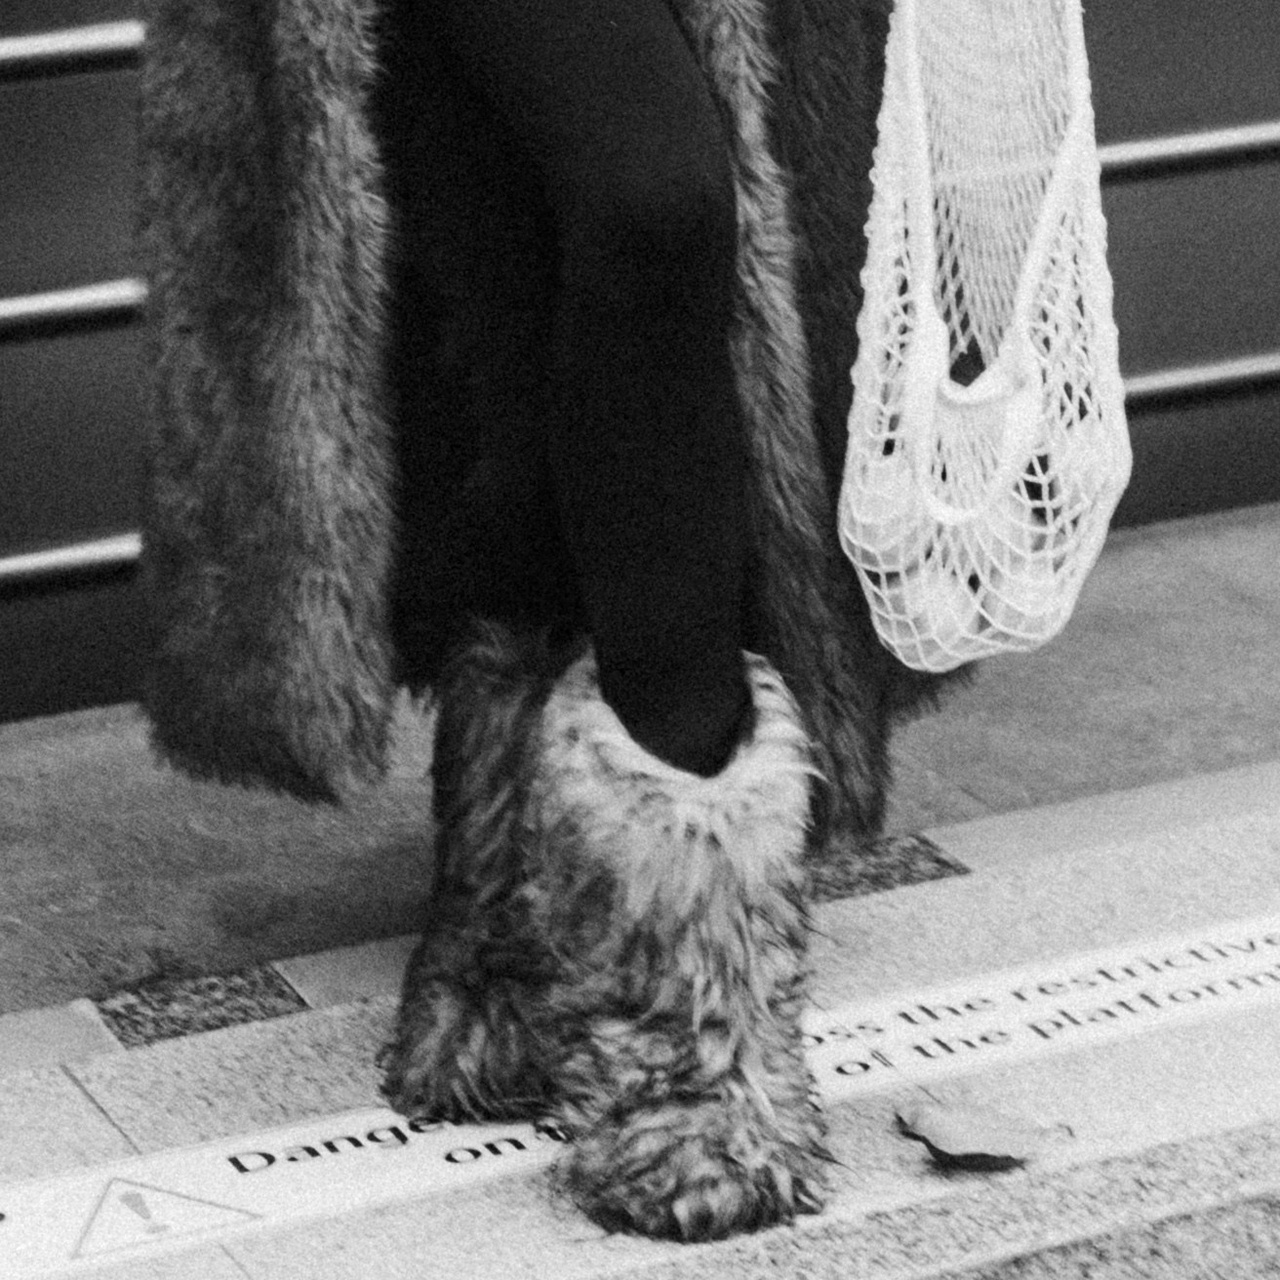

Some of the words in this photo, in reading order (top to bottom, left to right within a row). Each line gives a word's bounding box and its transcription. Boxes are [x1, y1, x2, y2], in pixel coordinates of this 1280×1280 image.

[228, 1116, 446, 1174] Dange
[898, 997, 994, 1025] the
[444, 1137, 527, 1164] on
[834, 1048, 895, 1076] of
[912, 1029, 1009, 1059] the
